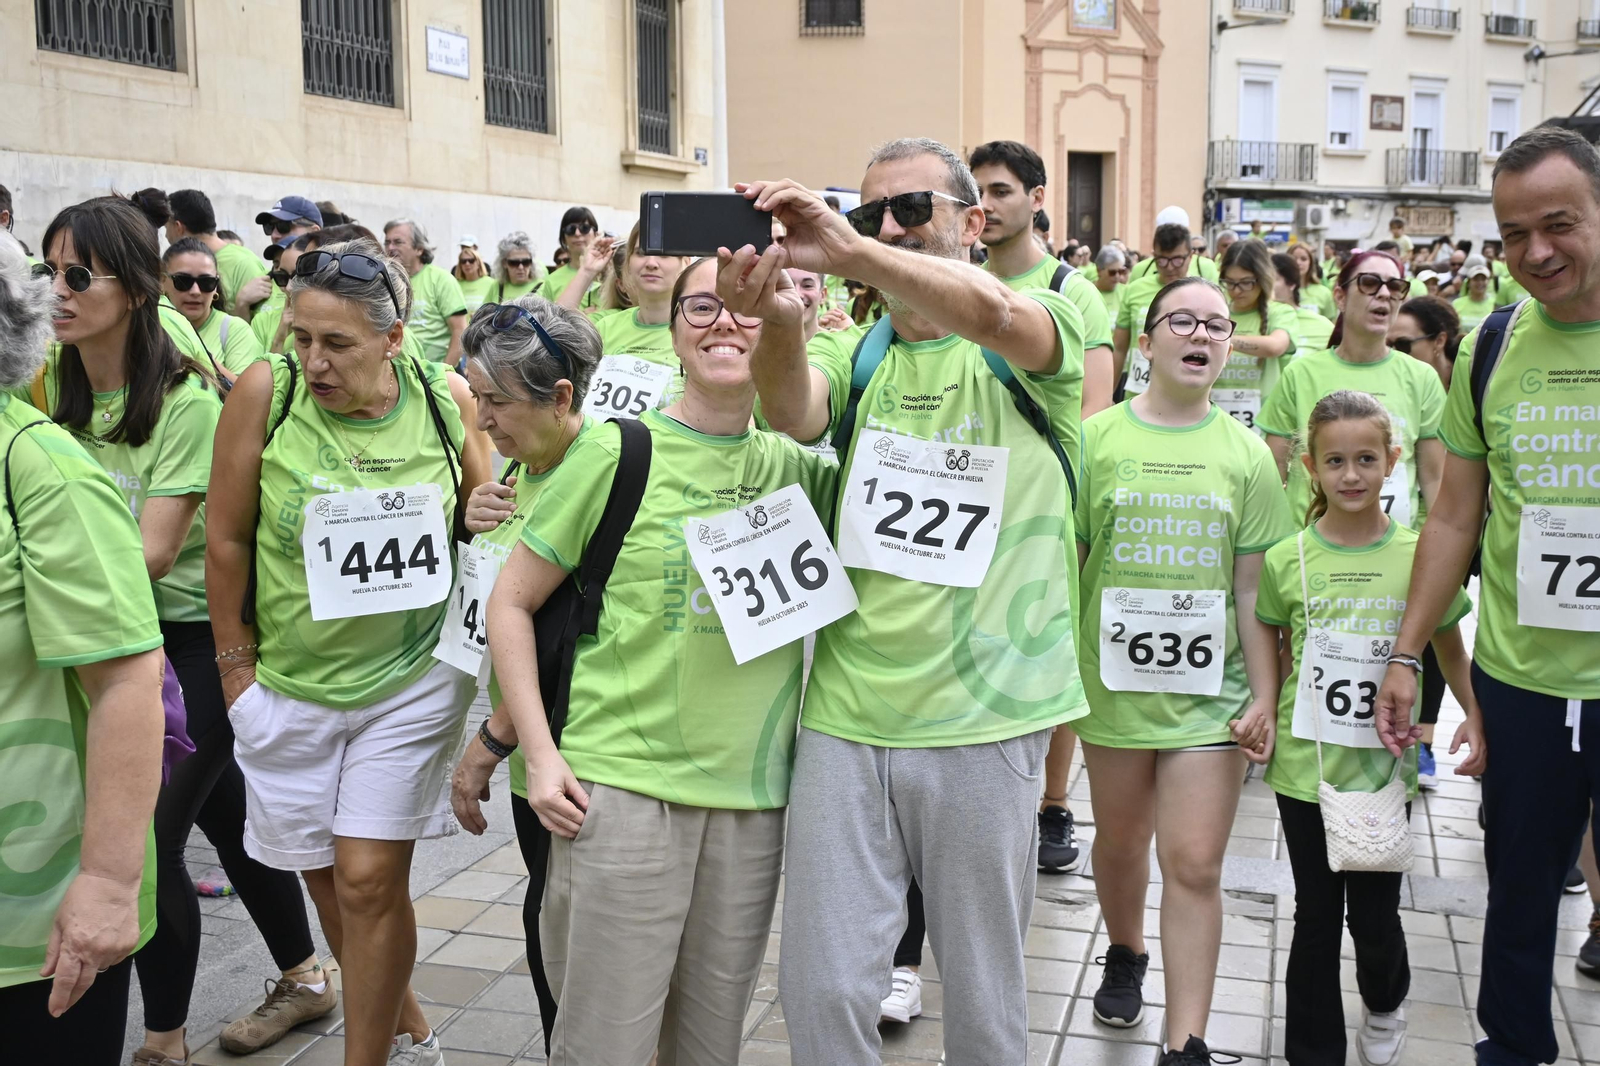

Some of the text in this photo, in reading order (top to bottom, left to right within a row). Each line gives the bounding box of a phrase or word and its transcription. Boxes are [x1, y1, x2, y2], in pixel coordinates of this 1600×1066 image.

[1516, 401, 1546, 422] En
[372, 456, 406, 466] española
[891, 451, 910, 459] Destino
[366, 465, 392, 473] cáncer
[883, 462, 906, 472] MARCHA
[907, 467, 928, 476] CONTRA
[936, 471, 958, 480] CÁNCER
[1114, 488, 1232, 513] En marcha
[350, 515, 370, 523] CONTRA
[377, 512, 397, 520] CÁNCER
[1114, 514, 1202, 536] contra
[715, 542, 732, 553] MARCHA
[771, 518, 791, 531] HUELVA
[880, 541, 901, 551] HUELVA
[909, 548, 933, 557] OCTUBRE
[663, 514, 688, 632] HUELVA
[1124, 570, 1154, 578] MARCHA
[1167, 572, 1195, 580] HUELVA
[378, 583, 401, 592] OCTUBRE
[1310, 595, 1406, 611] En marcha
[757, 617, 771, 627] HUELVA
[776, 606, 797, 620] OCTUBRE
[796, 601, 808, 610] 2025
[700, 626, 724, 634] MARC
[1310, 614, 1402, 633] contra el
